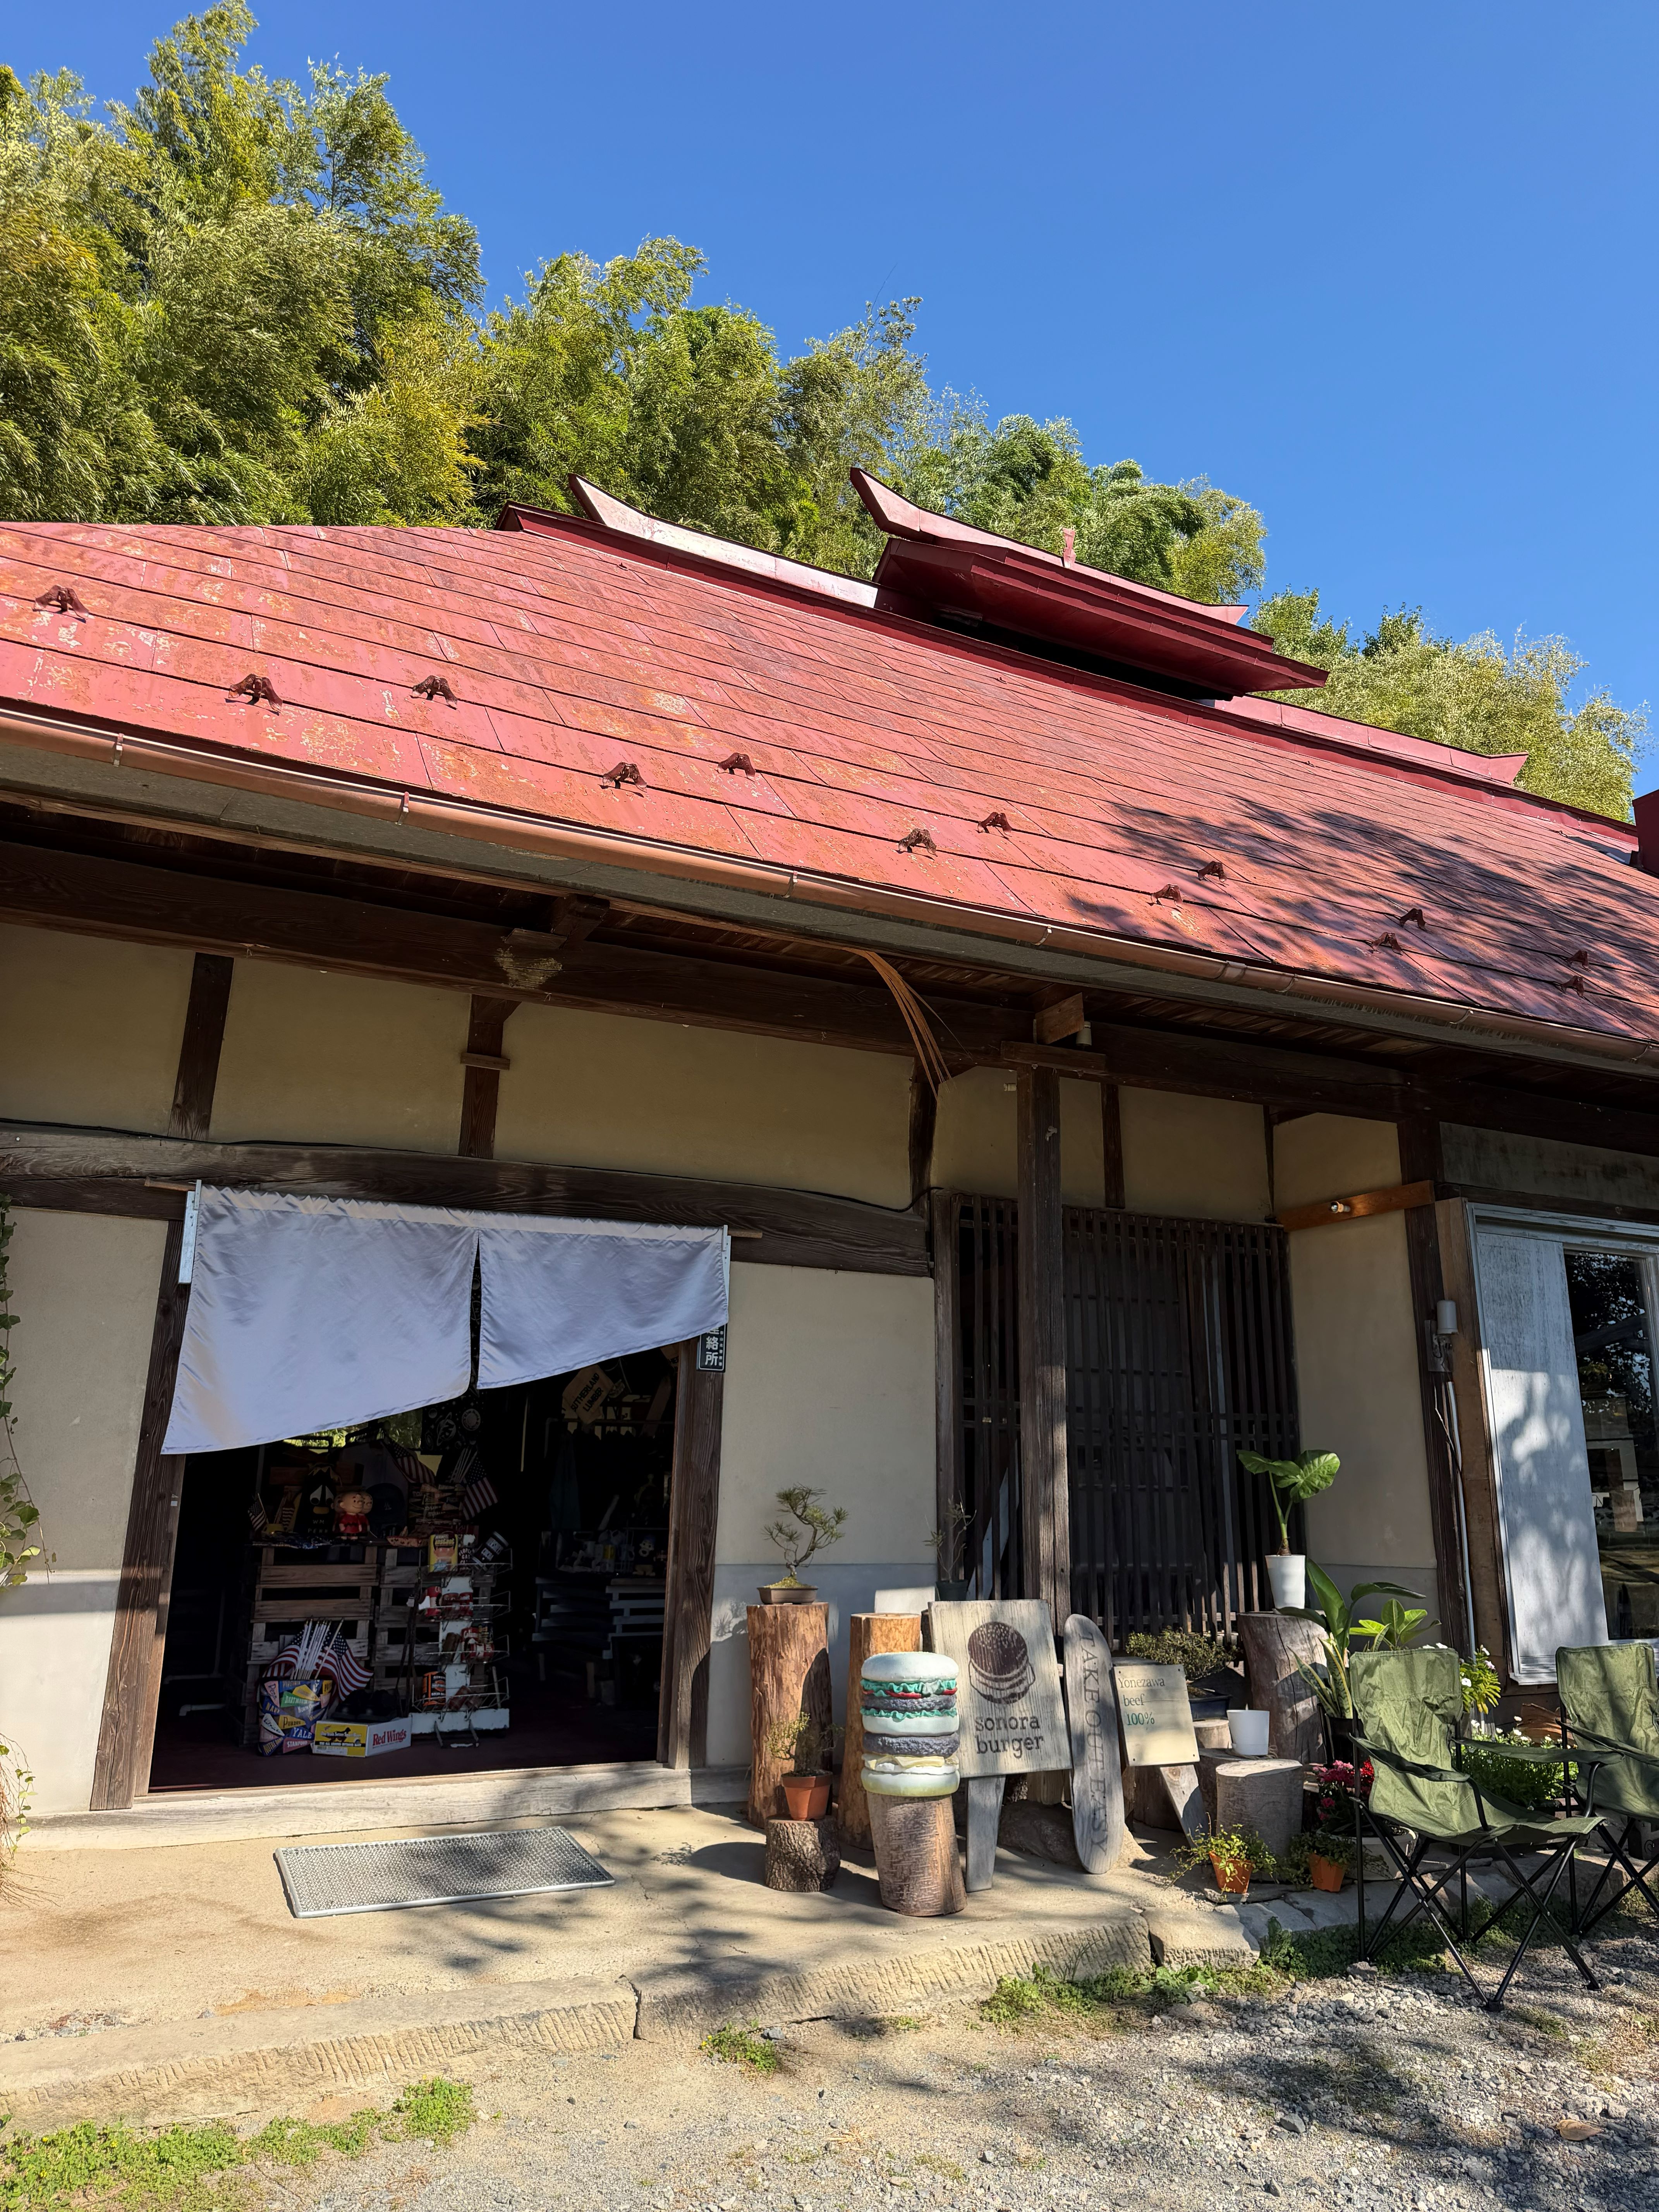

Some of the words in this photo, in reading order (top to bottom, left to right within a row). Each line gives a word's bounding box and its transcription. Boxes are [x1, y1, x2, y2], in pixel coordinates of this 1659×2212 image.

[571, 1373, 599, 1412] SUTHERLAND
[583, 1387, 603, 1412] LUMBER
[1079, 1632, 1100, 1703] TAKE
[268, 1683, 277, 1699] Penn
[1118, 1678, 1165, 1688] Yonezawa
[1123, 1693, 1144, 1707] beef
[975, 1716, 1040, 1731] sonora
[1127, 1712, 1155, 1726] 100%
[293, 1727, 312, 1739] YALE
[373, 1731, 385, 1746] Red
[387, 1729, 407, 1742] Wings
[1085, 1709, 1104, 1771] OUT
[975, 1735, 1044, 1759] burger
[1089, 1776, 1108, 1856] EASY
